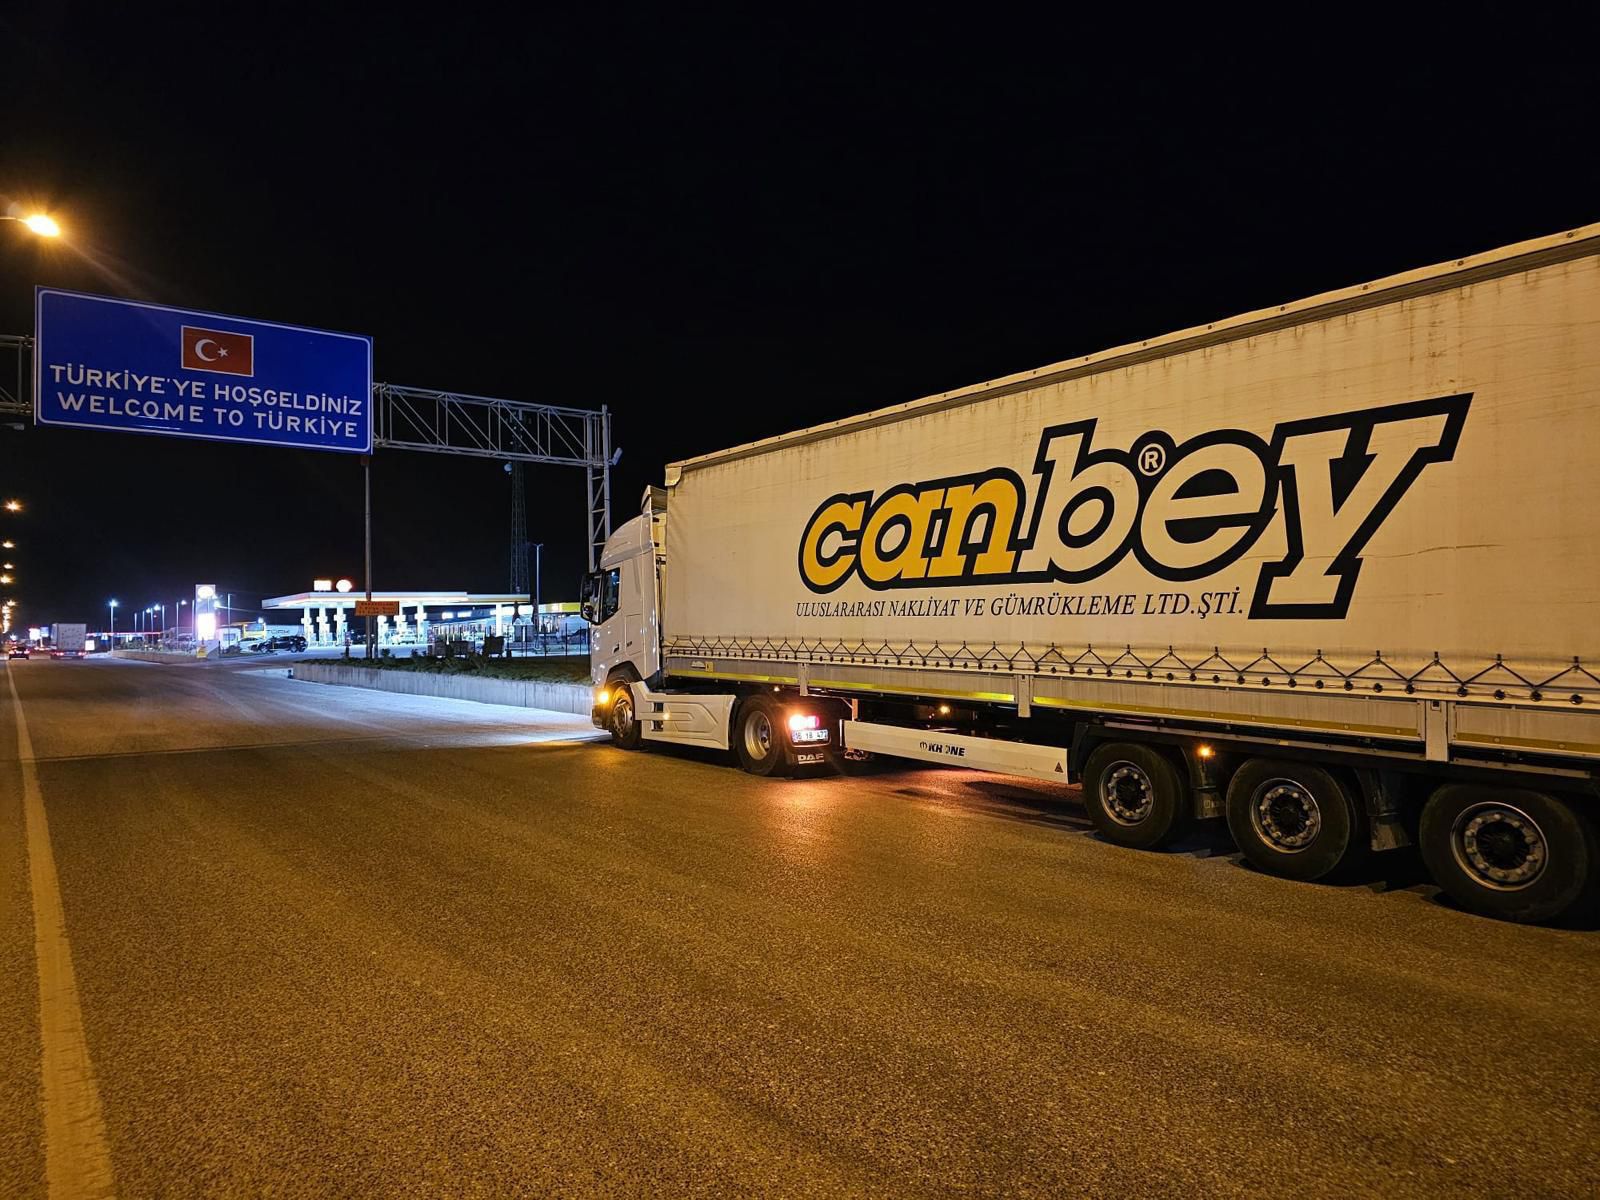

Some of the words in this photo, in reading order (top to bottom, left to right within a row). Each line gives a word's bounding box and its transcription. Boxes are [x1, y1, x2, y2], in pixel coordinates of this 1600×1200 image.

[50, 363, 205, 398] TÜRKİYE'YE
[214, 383, 362, 416] HOŞGELDİNİZ
[57, 391, 204, 423] WELCOME
[213, 407, 244, 426] TO
[253, 410, 358, 438] TÜRKİYE
[798, 392, 1473, 620] canbey
[796, 600, 885, 617] ULUSLARARASI
[888, 596, 960, 617] NAKLİYAT
[964, 598, 986, 616] VE
[990, 592, 1136, 616] GÜMRÜKLEME
[797, 753, 824, 761] DAF
